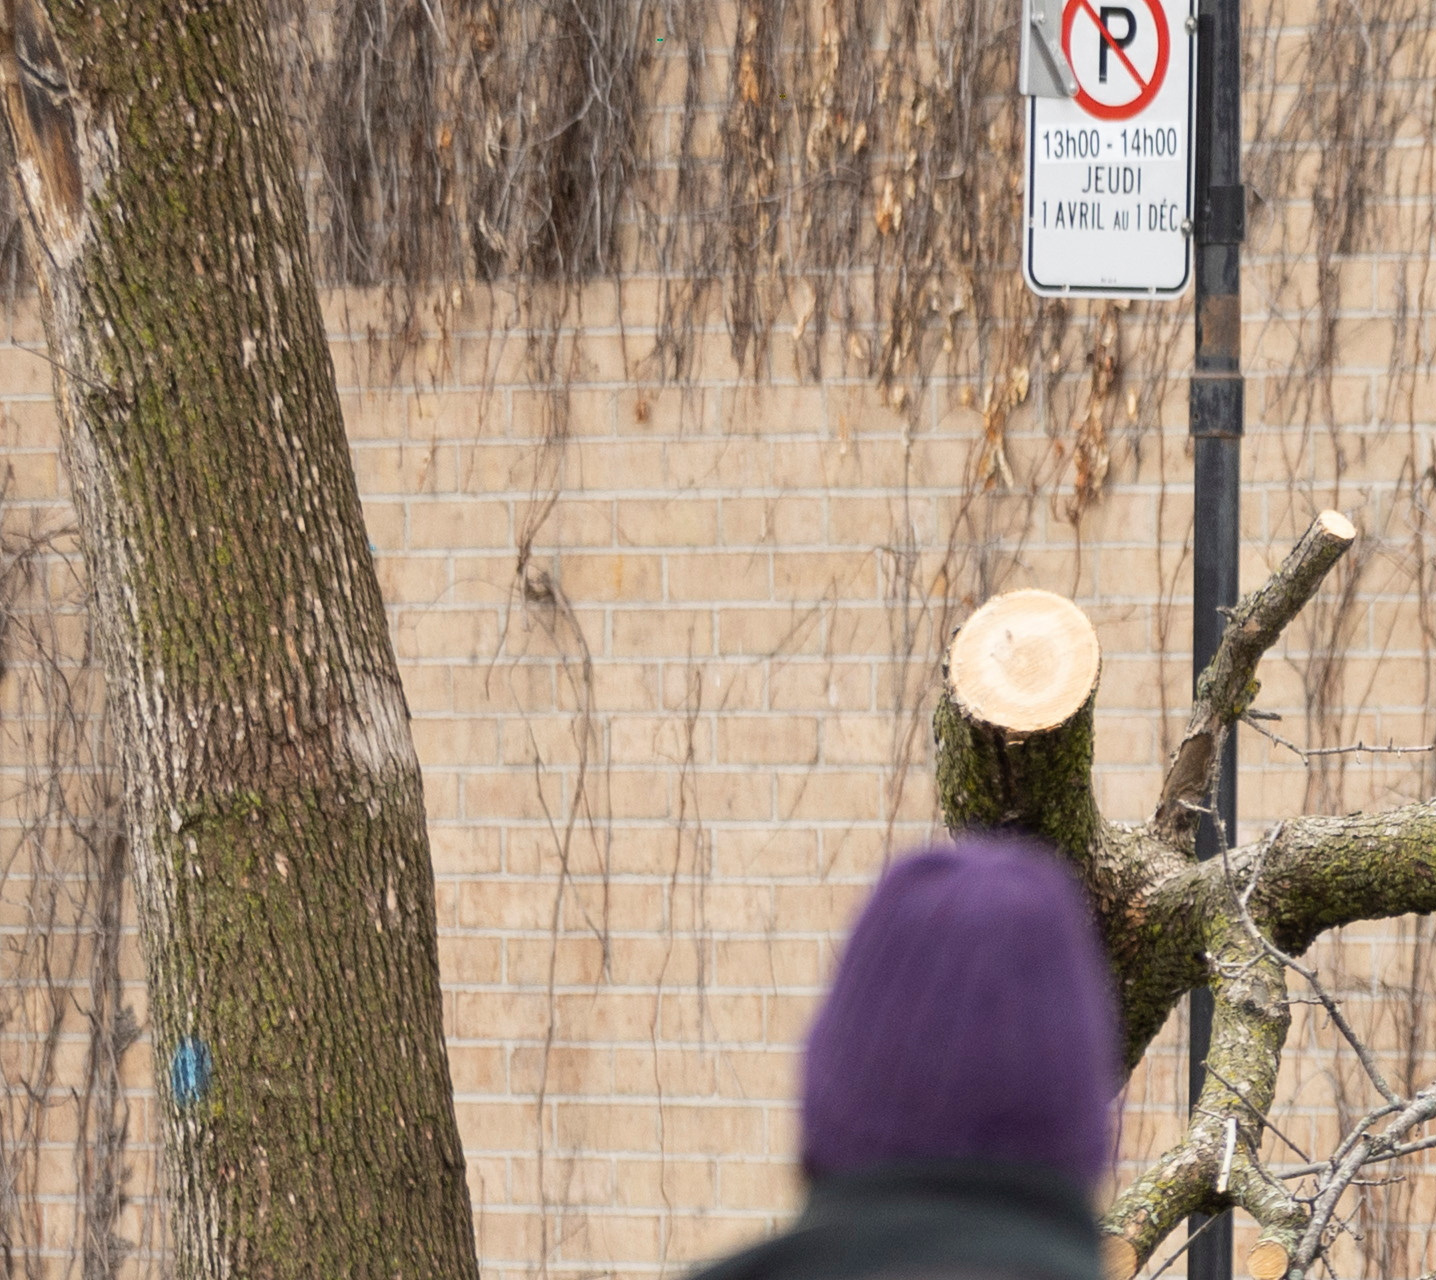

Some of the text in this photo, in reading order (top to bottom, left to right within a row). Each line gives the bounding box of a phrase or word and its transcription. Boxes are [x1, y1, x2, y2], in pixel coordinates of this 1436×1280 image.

[1043, 129, 1101, 160] 13h00
[1120, 127, 1178, 158] 14h00
[1081, 165, 1142, 195] JEUDI
[1041, 199, 1179, 232] 1 AVRIL AU 1 DÉC
